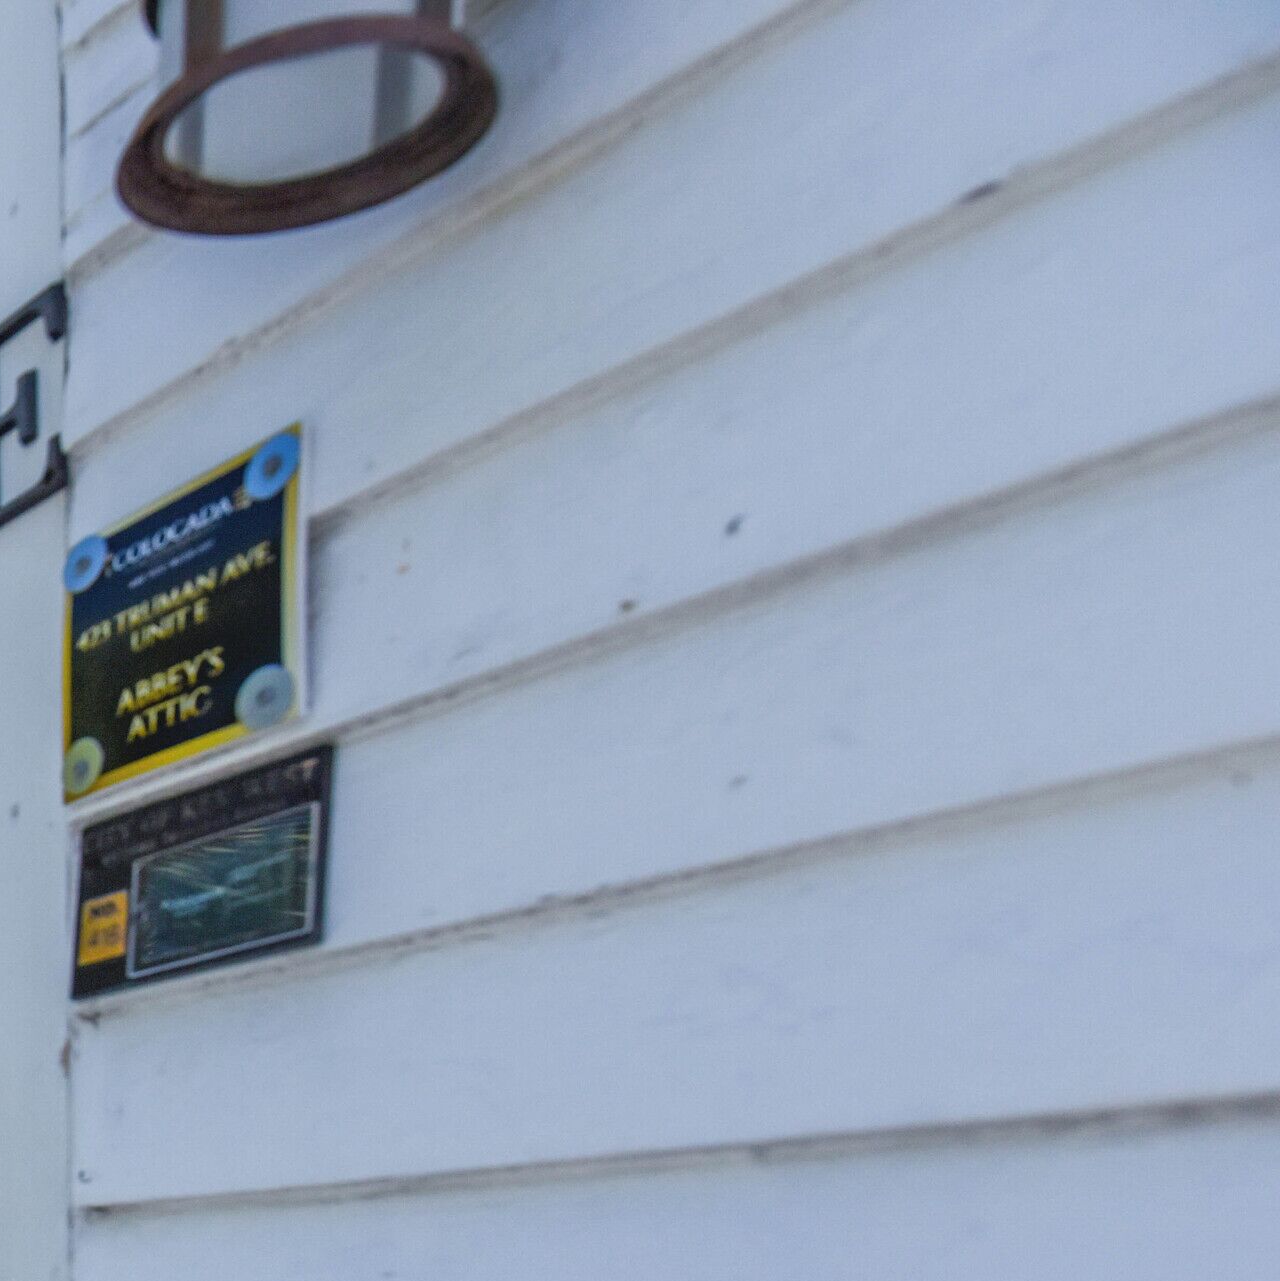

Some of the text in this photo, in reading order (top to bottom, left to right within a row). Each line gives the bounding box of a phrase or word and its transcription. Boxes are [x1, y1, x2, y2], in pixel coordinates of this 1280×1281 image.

[114, 566, 218, 635] TRUMAN
[130, 597, 209, 652] UNIT E
[117, 646, 226, 717] ABBEY'S
[127, 685, 213, 743] ATTIC
